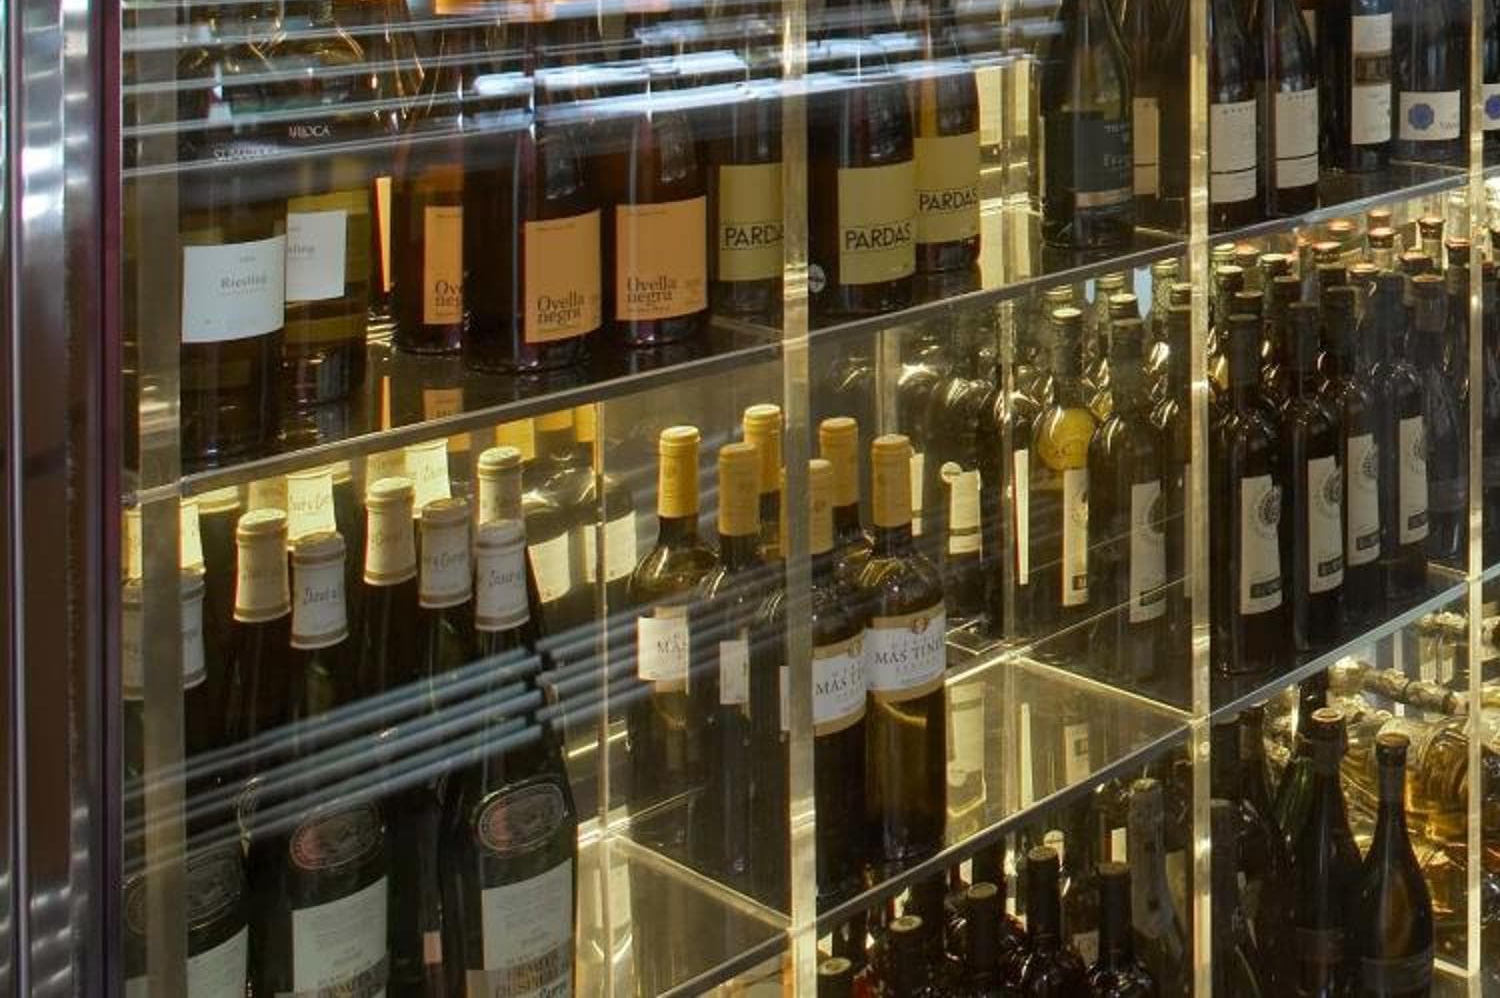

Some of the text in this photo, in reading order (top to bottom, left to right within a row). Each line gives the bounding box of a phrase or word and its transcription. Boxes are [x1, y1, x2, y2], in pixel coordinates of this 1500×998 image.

[918, 187, 978, 211] PARDAS
[845, 222, 911, 251] PARDAS
[626, 276, 677, 294] Ovella
[537, 291, 585, 311] Ovella
[626, 291, 673, 307] negra
[537, 306, 581, 326] negra
[874, 649, 908, 665] MAS
